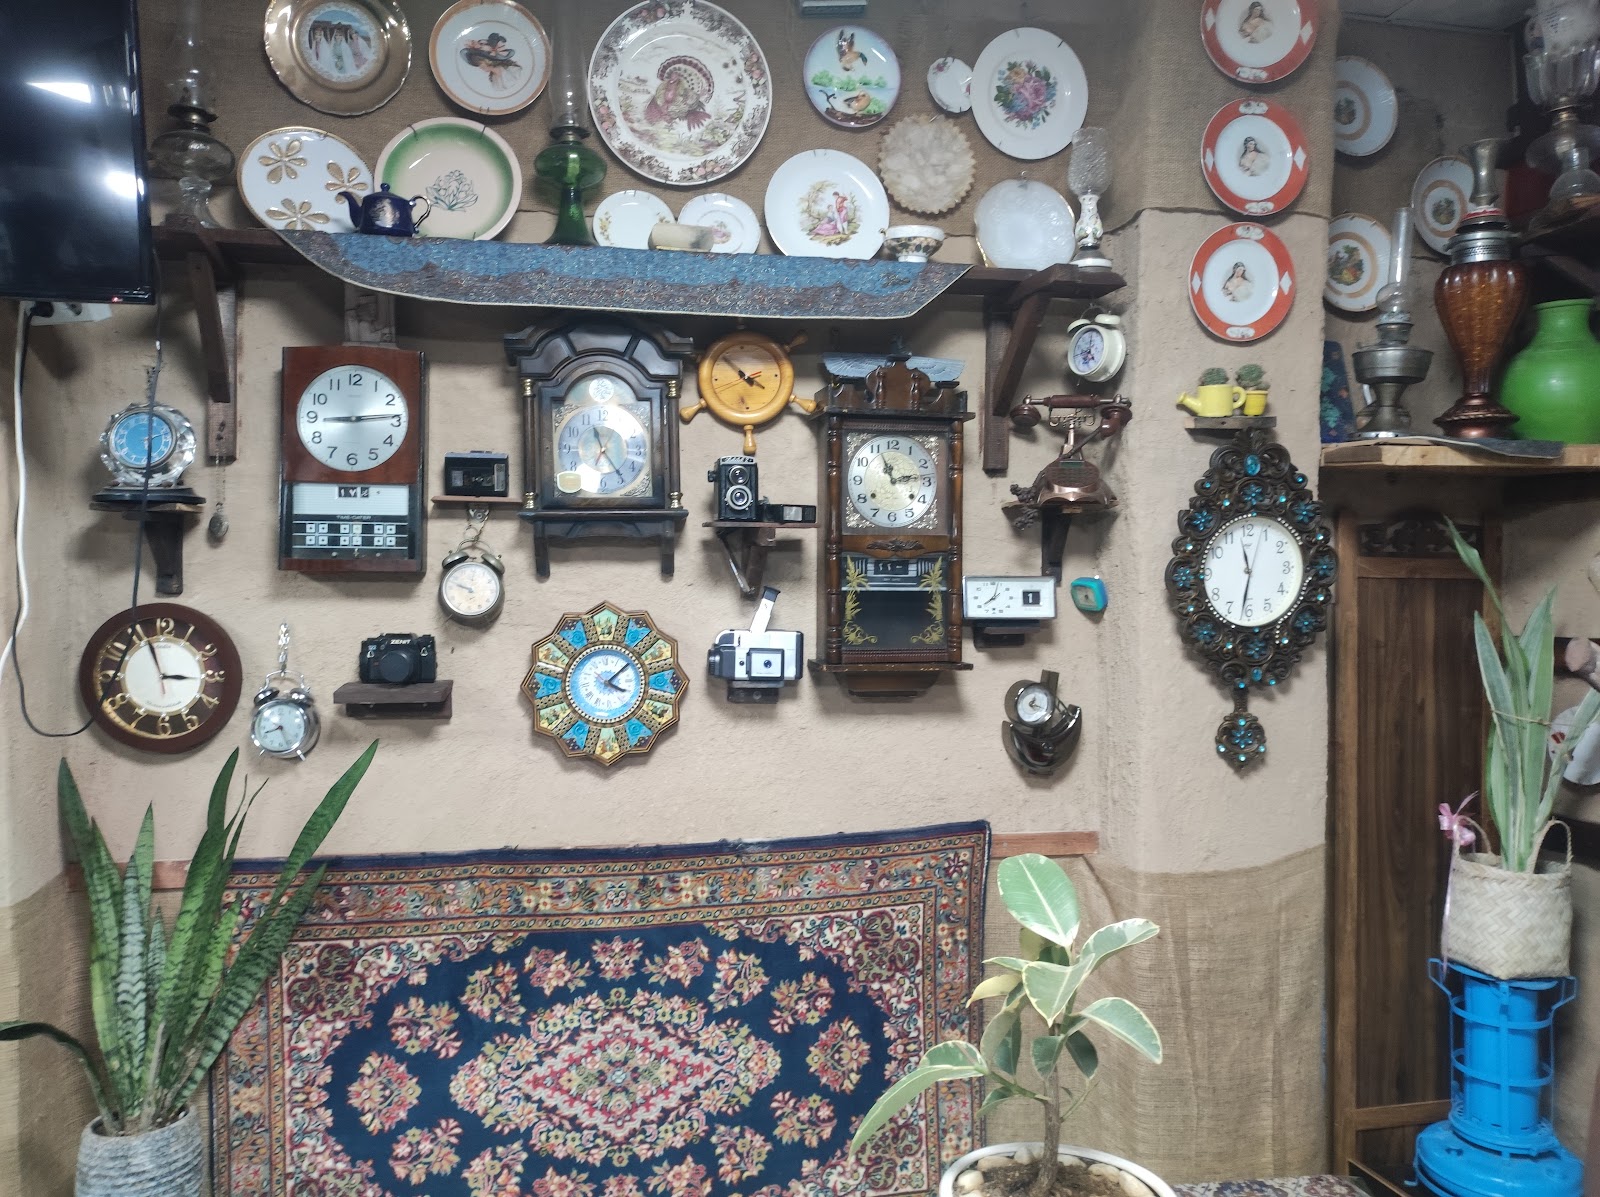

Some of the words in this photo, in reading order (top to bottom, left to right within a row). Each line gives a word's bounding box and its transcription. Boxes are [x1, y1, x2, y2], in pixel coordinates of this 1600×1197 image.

[329, 379, 340, 391] 11
[348, 373, 363, 386] 12
[374, 380, 378, 392] 1
[313, 393, 328, 406] 10
[385, 393, 396, 406] 2
[306, 410, 318, 423] 9
[390, 414, 402, 428] 3
[582, 414, 590, 425] 11
[598, 410, 609, 421] 12
[311, 431, 322, 444] 8
[568, 426, 579, 437] 10
[383, 434, 394, 447] 4
[886, 440, 900, 450] 12
[327, 446, 338, 459] 7
[368, 448, 379, 461] 5
[564, 444, 571, 454] 9
[635, 444, 642, 457] 3
[870, 444, 880, 454] 11
[908, 445, 913, 455] 1
[346, 453, 358, 466] 6
[570, 460, 577, 471] 8
[857, 457, 869, 467] 10
[918, 459, 928, 469] 2
[629, 461, 635, 472] 4
[600, 476, 607, 492] 6
[853, 475, 862, 486] 9
[922, 477, 932, 487] 3
[857, 494, 867, 504] 8
[917, 494, 926, 504] 4
[870, 508, 880, 517] 7
[887, 511, 897, 522] 6
[905, 508, 914, 518] 5
[1241, 524, 1254, 537] 12
[1263, 528, 1268, 541] 1
[1224, 532, 1234, 544] 11
[1210, 546, 1223, 559] 10
[1276, 540, 1285, 554] 2
[1204, 567, 1212, 581] 9
[1282, 561, 1291, 574] 3
[1211, 587, 1220, 601] 8
[1277, 582, 1285, 595] 4
[1027, 593, 1033, 603] 1
[1263, 598, 1271, 611] 5
[1225, 601, 1234, 614] 7
[1245, 604, 1253, 617] 6
[155, 617, 175, 637] 12
[184, 624, 195, 641] 1
[199, 643, 218, 662] 2
[108, 693, 130, 711] 8
[200, 693, 220, 709] 4
[130, 708, 148, 729] 7
[181, 710, 199, 729] 5
[158, 715, 171, 736] 6
